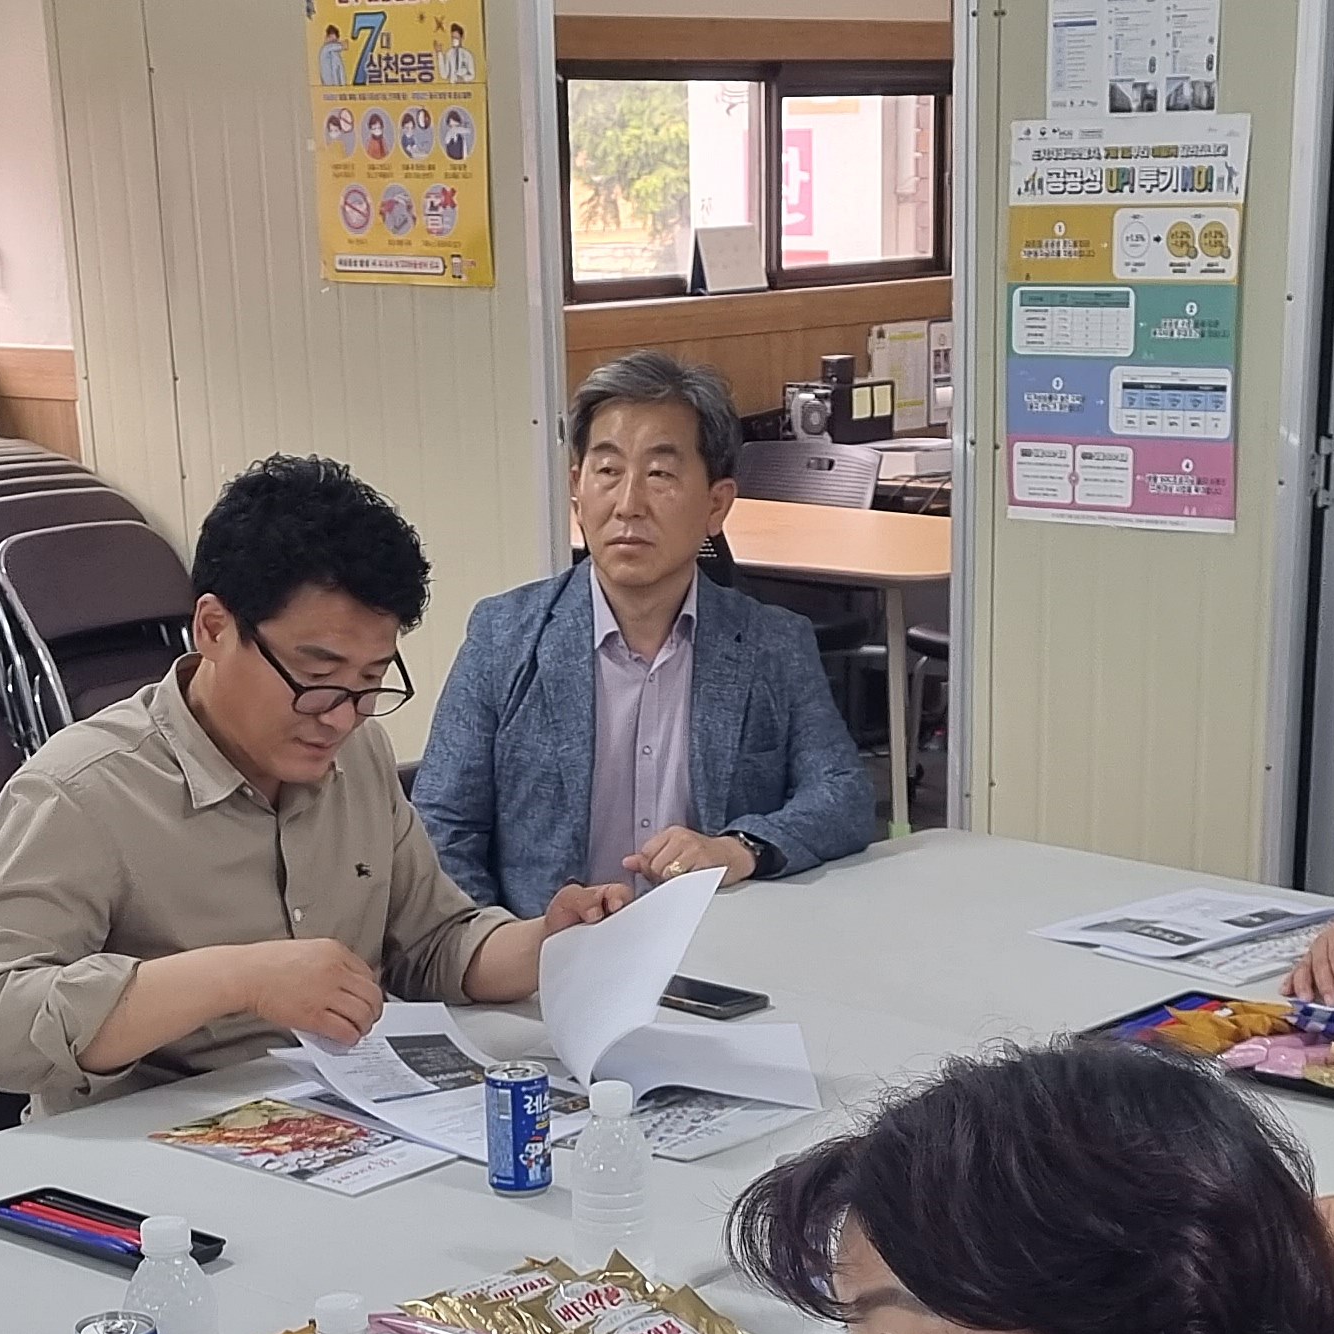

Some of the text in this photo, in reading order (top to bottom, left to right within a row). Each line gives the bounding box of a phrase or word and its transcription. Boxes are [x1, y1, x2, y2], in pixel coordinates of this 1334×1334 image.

[351, 11, 387, 86] 7
[366, 52, 435, 84] 실천운동
[1046, 164, 1213, 194] 공공성 UP! 투기 NO!
[523, 1092, 550, 1115] 레
[555, 1284, 624, 1322] 버터와플
